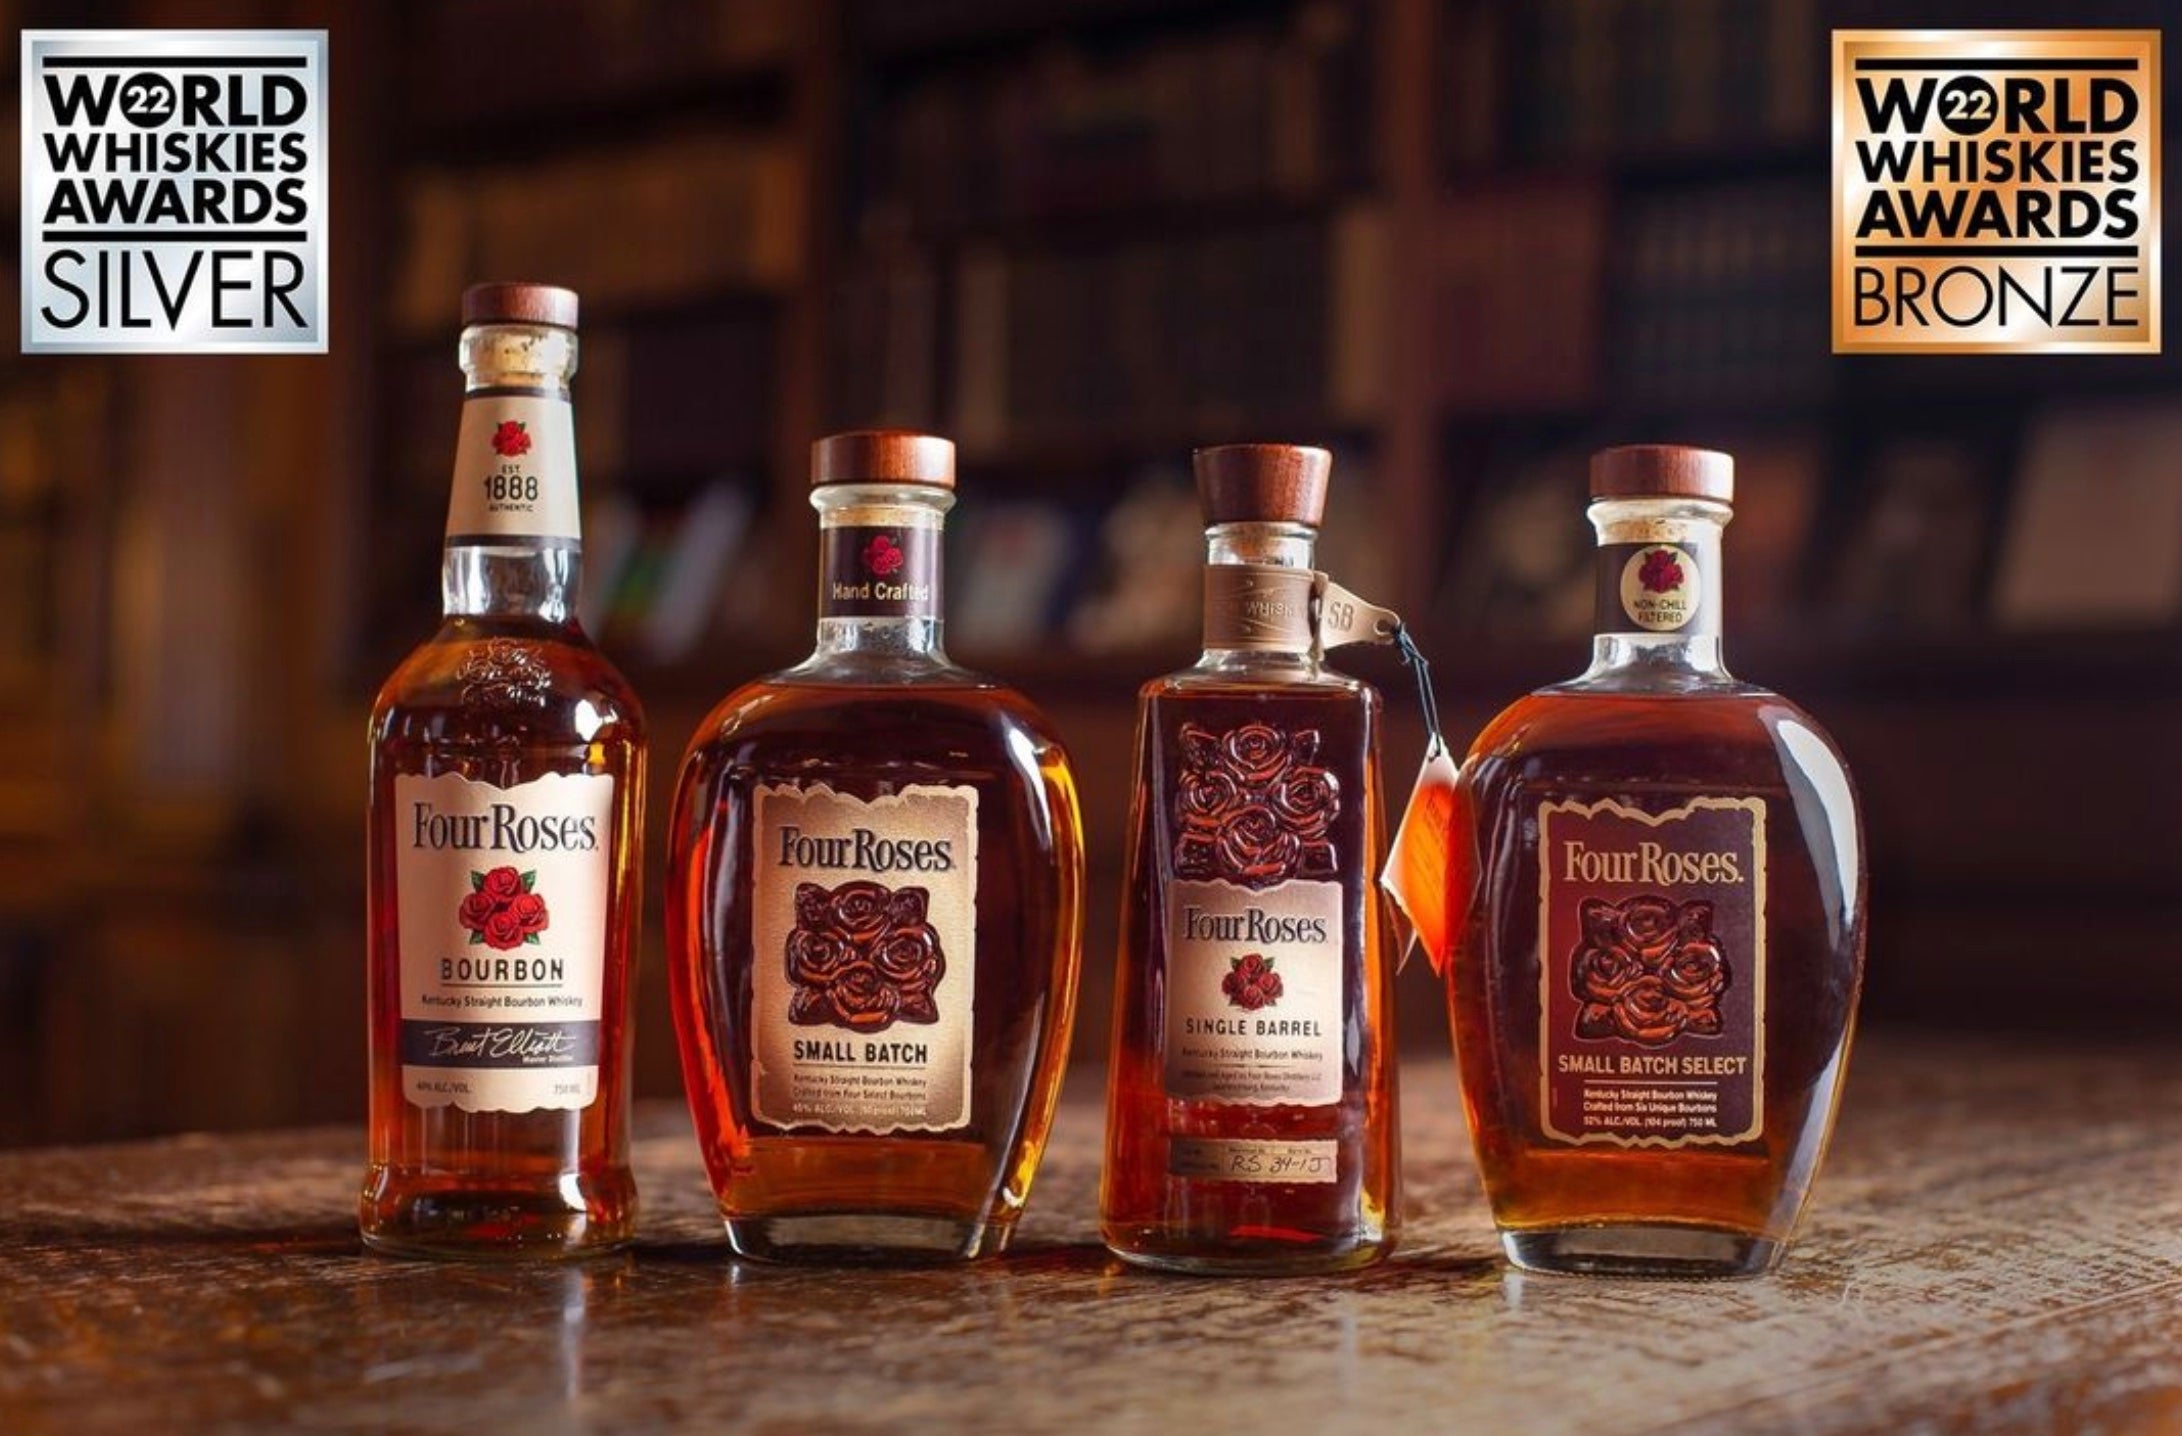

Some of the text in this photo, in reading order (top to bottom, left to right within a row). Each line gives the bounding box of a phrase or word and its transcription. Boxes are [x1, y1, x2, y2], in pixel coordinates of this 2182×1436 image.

[501, 464, 521, 474] EST
[483, 474, 538, 501] 1888
[832, 582, 929, 600] Hand Crafted
[1633, 599, 1687, 611] NON-CHILL
[1637, 611, 1684, 623] FILTERED
[440, 958, 564, 981] BOURBON
[421, 994, 462, 1009] Kentucky
[464, 995, 502, 1009] Straight
[504, 995, 546, 1007] Bourbon
[1185, 1018, 1323, 1037] SINGLE BARREL
[793, 1040, 928, 1064] SMALL BATCH
[1220, 1047, 1253, 1060] Straight
[1254, 1048, 1289, 1059] Bourbon
[1558, 1054, 1747, 1076] SMALL BATCH SELECT
[1583, 1089, 1718, 1102] Kentucky Straight Bourbon Whiskey
[1583, 1101, 1614, 1112] Crafted
[1614, 1102, 1634, 1112] from
[1648, 1102, 1677, 1114] Unique
[1678, 1102, 1718, 1113] Bourbons
